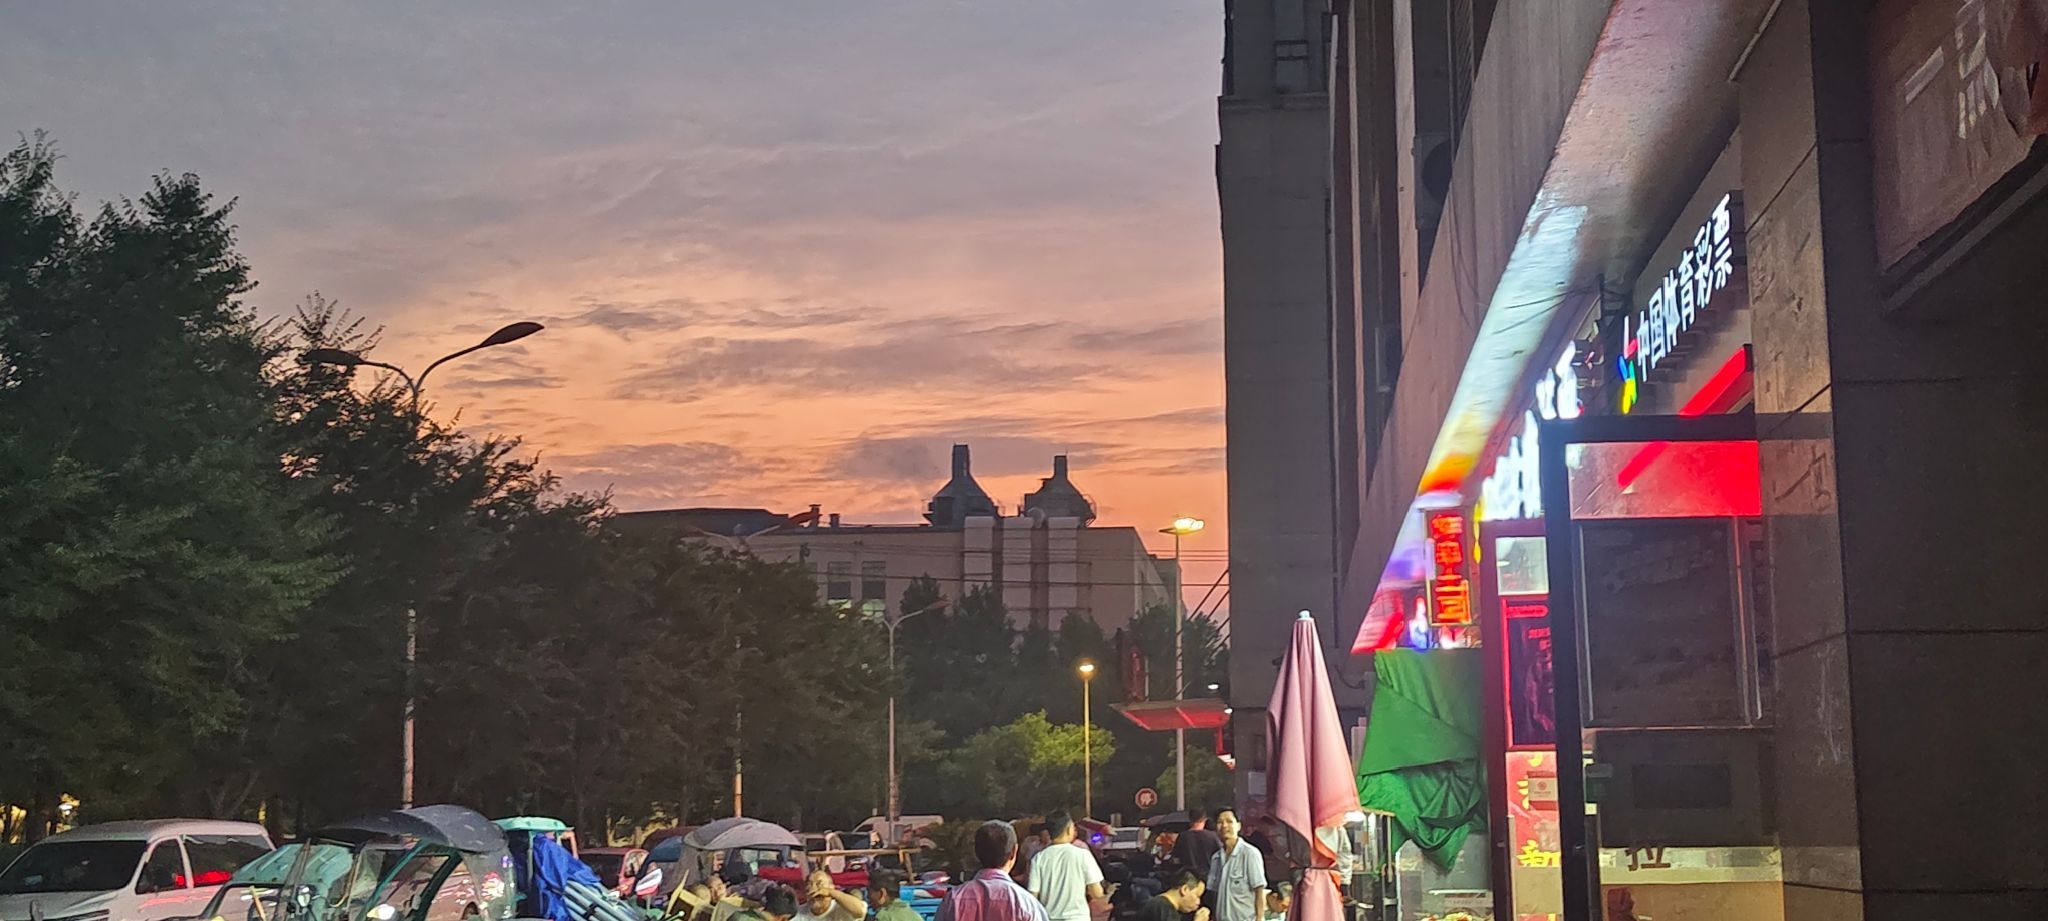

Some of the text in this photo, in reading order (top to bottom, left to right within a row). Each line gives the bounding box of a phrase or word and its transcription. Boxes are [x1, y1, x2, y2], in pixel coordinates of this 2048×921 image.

[1636, 193, 1733, 382] 中国体育彩票
